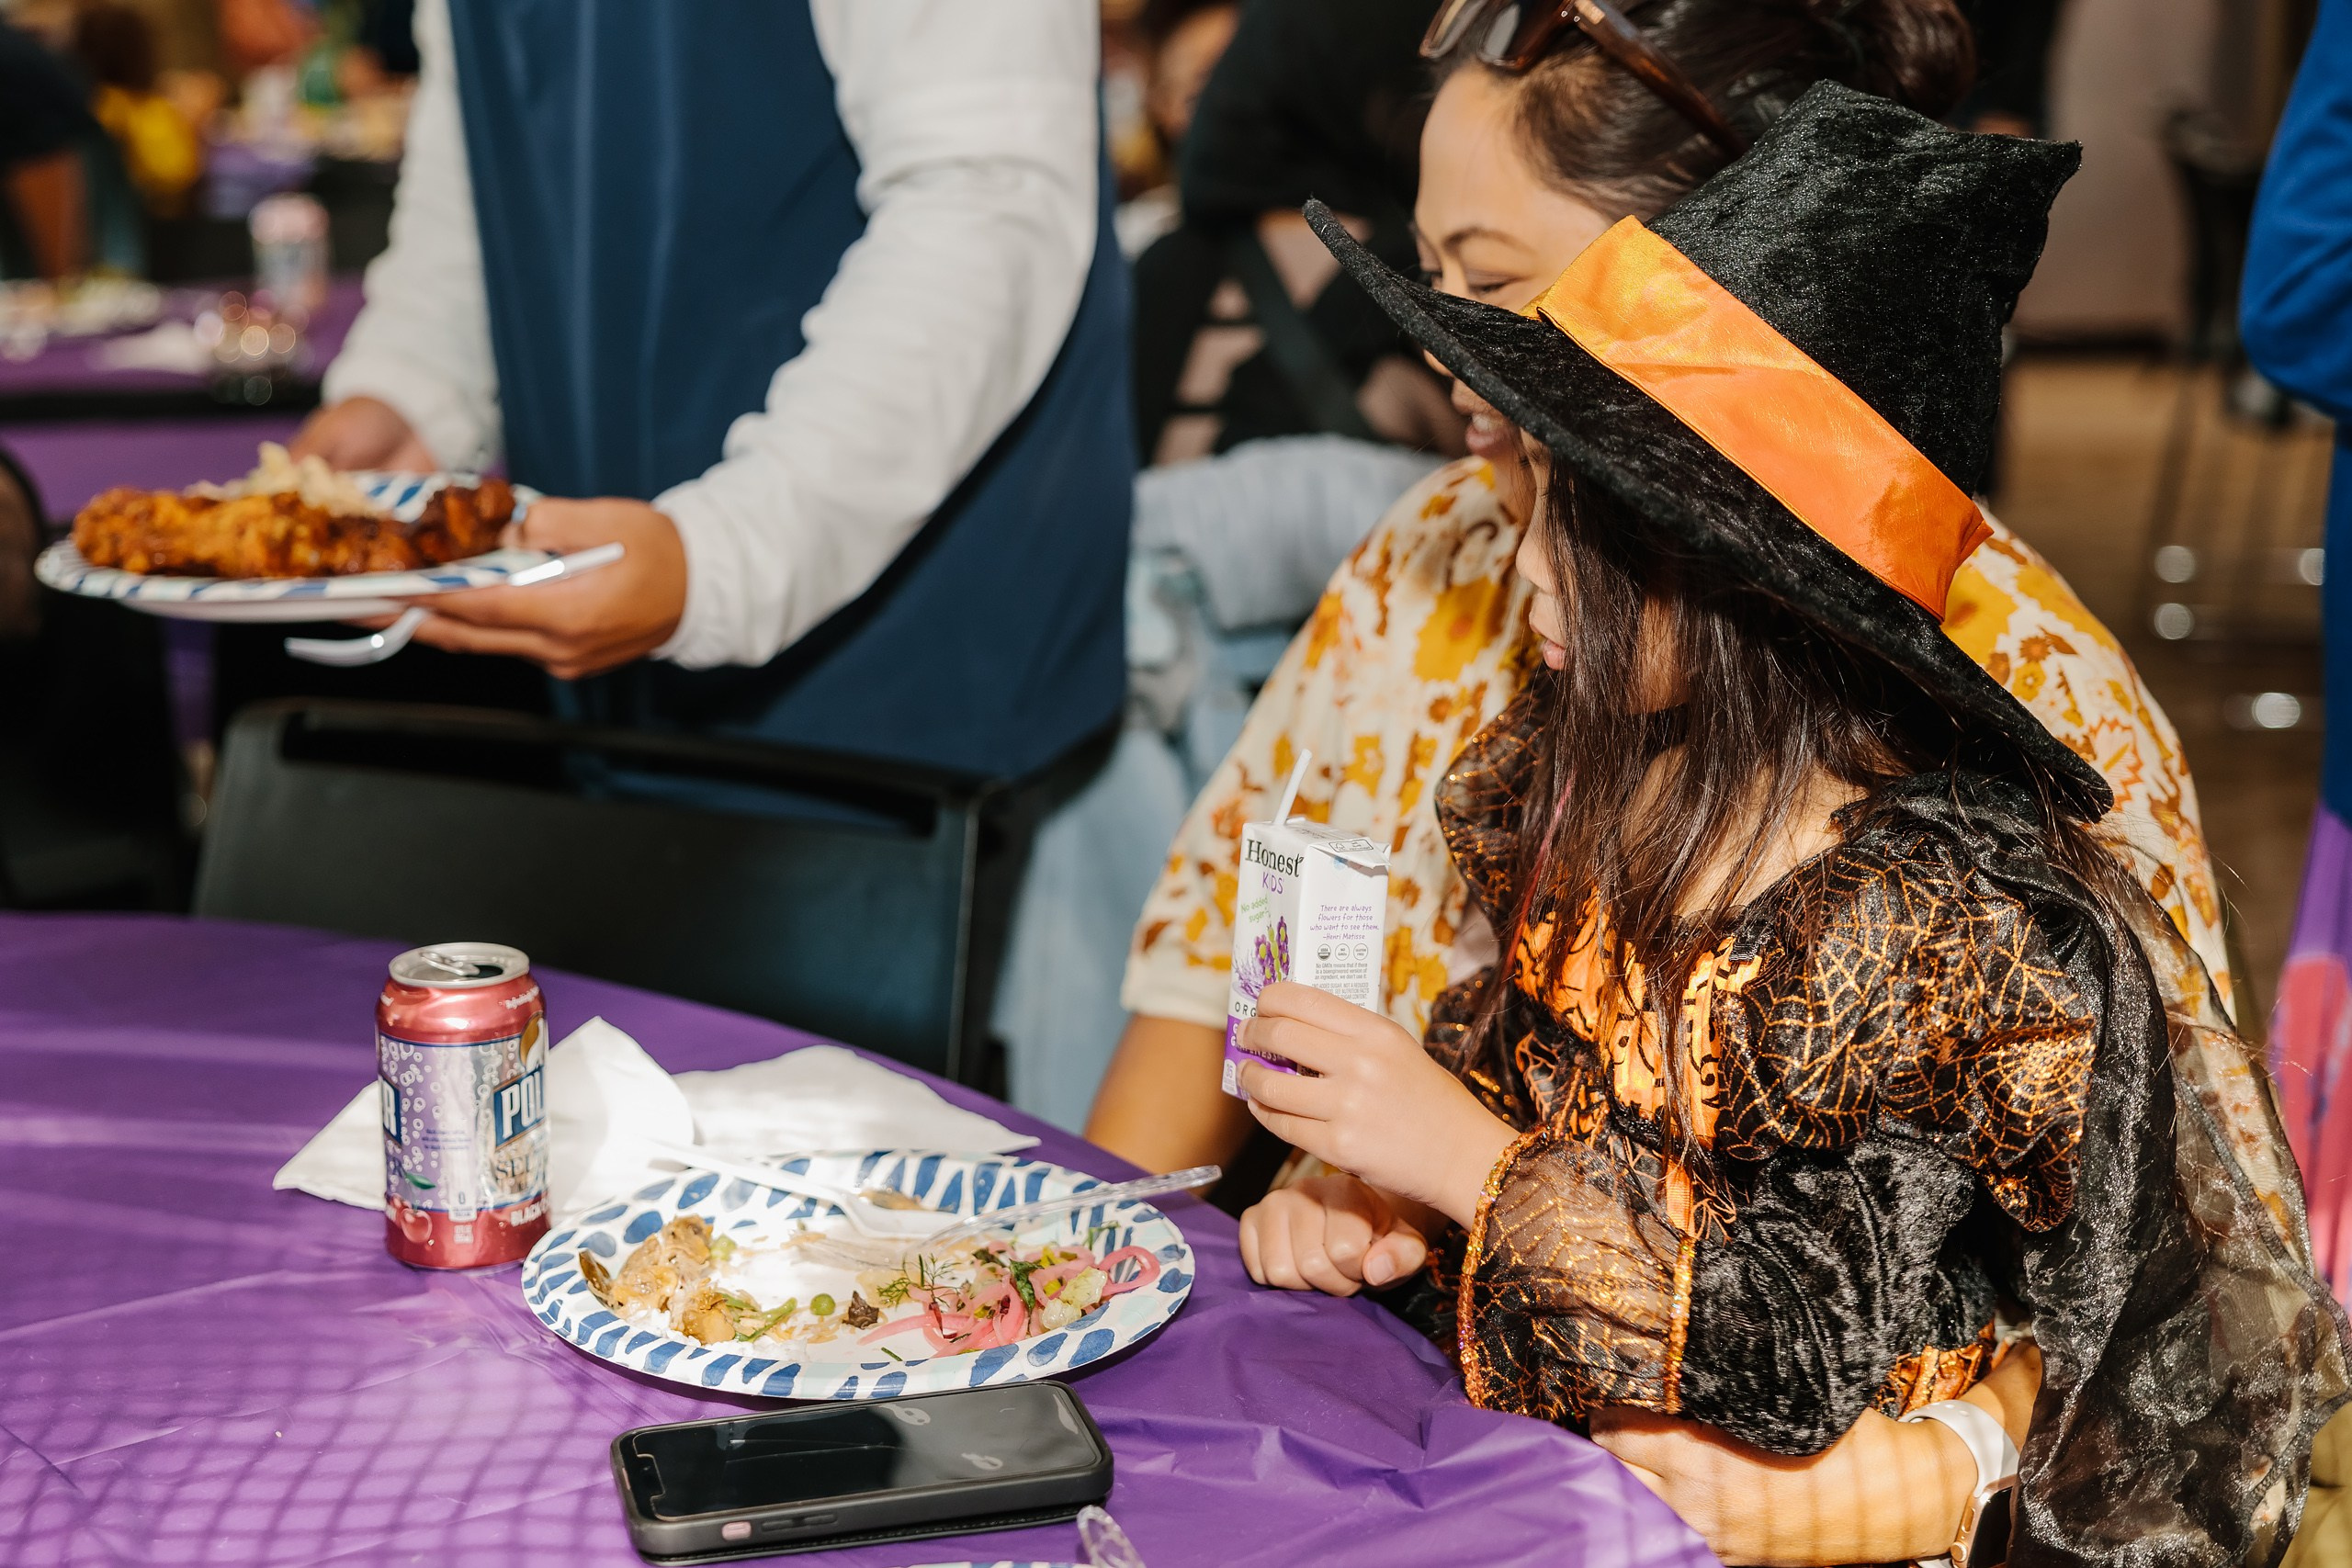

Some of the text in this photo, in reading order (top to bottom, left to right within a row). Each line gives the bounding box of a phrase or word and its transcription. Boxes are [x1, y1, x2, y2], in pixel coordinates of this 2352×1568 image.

[1245, 839, 1305, 878] Honest
[1240, 894, 1268, 914] No added
[1351, 904, 1373, 914] always
[1318, 913, 1374, 921] flowers for those
[501, 1071, 545, 1139] POL
